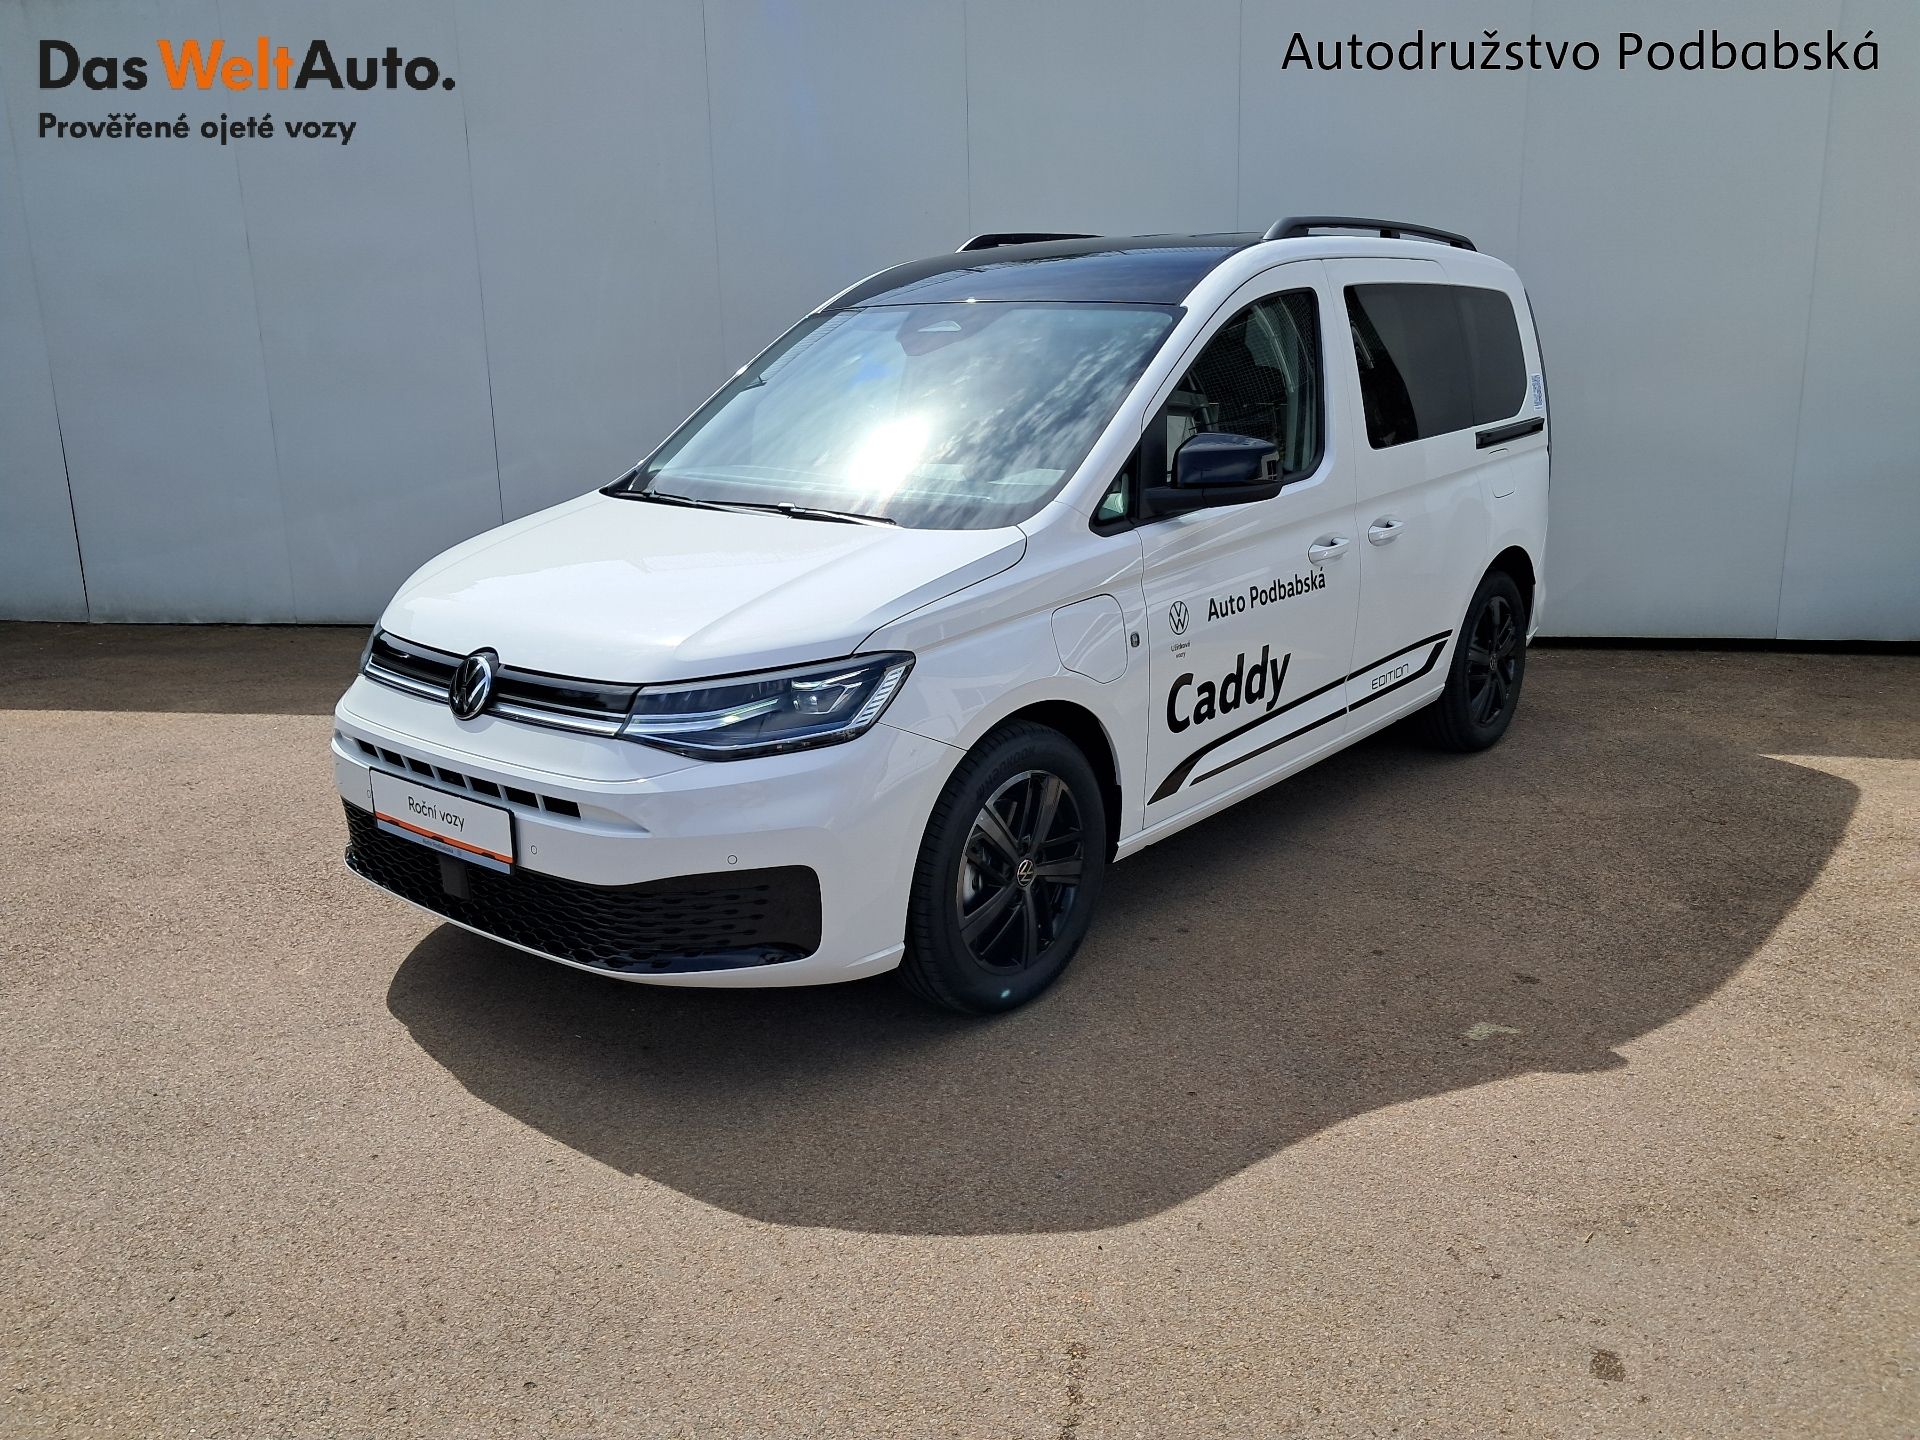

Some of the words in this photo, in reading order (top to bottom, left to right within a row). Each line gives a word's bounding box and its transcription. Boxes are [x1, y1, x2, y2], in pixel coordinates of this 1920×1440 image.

[1207, 594, 1246, 622] Auto
[1249, 567, 1326, 609] Podbabská
[1166, 644, 1292, 734] Caddy
[1371, 663, 1409, 690] EDITION
[408, 795, 437, 820] Roční
[439, 810, 465, 832] vozy
